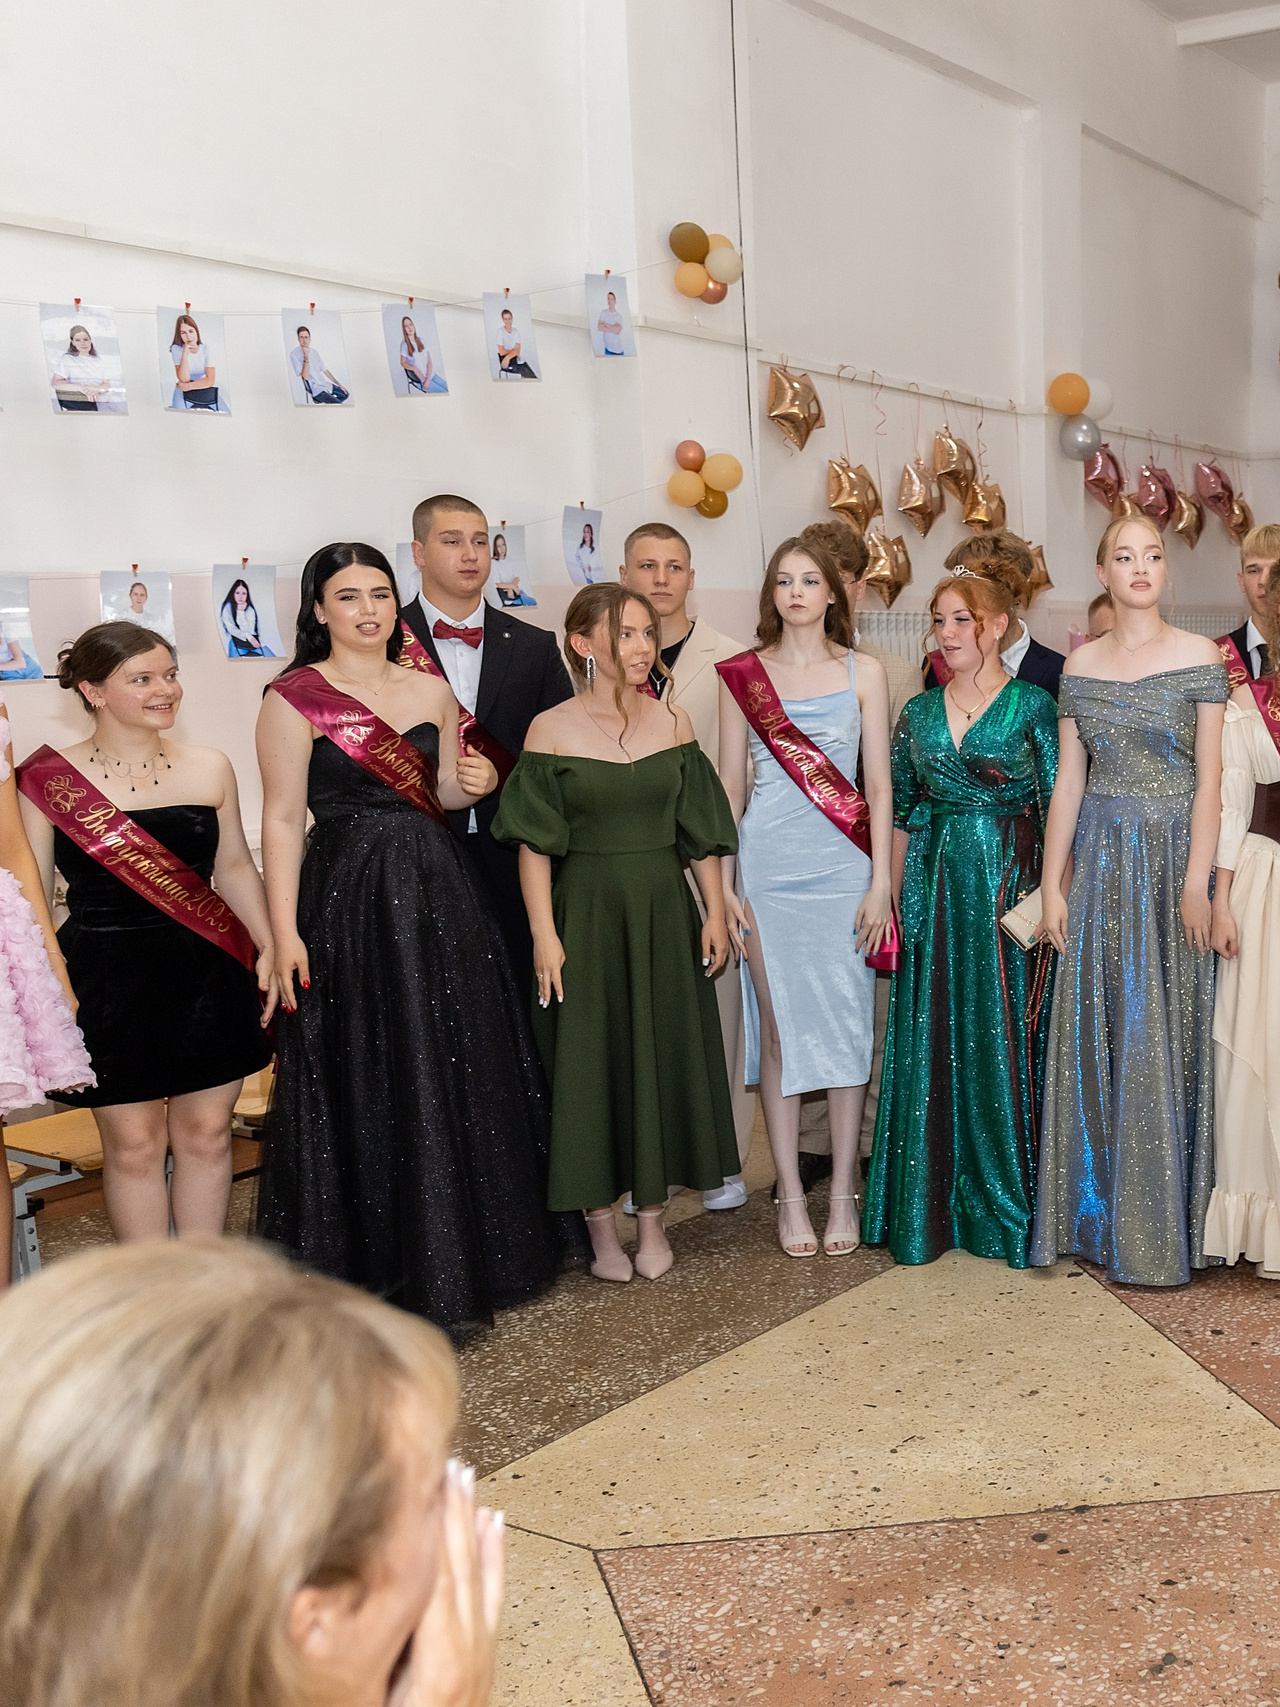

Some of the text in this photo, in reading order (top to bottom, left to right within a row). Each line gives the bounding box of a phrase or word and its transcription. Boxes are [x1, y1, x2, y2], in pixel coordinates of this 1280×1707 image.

[758, 707, 842, 806] Выпускница
[75, 800, 236, 933] Выпускница 2025
